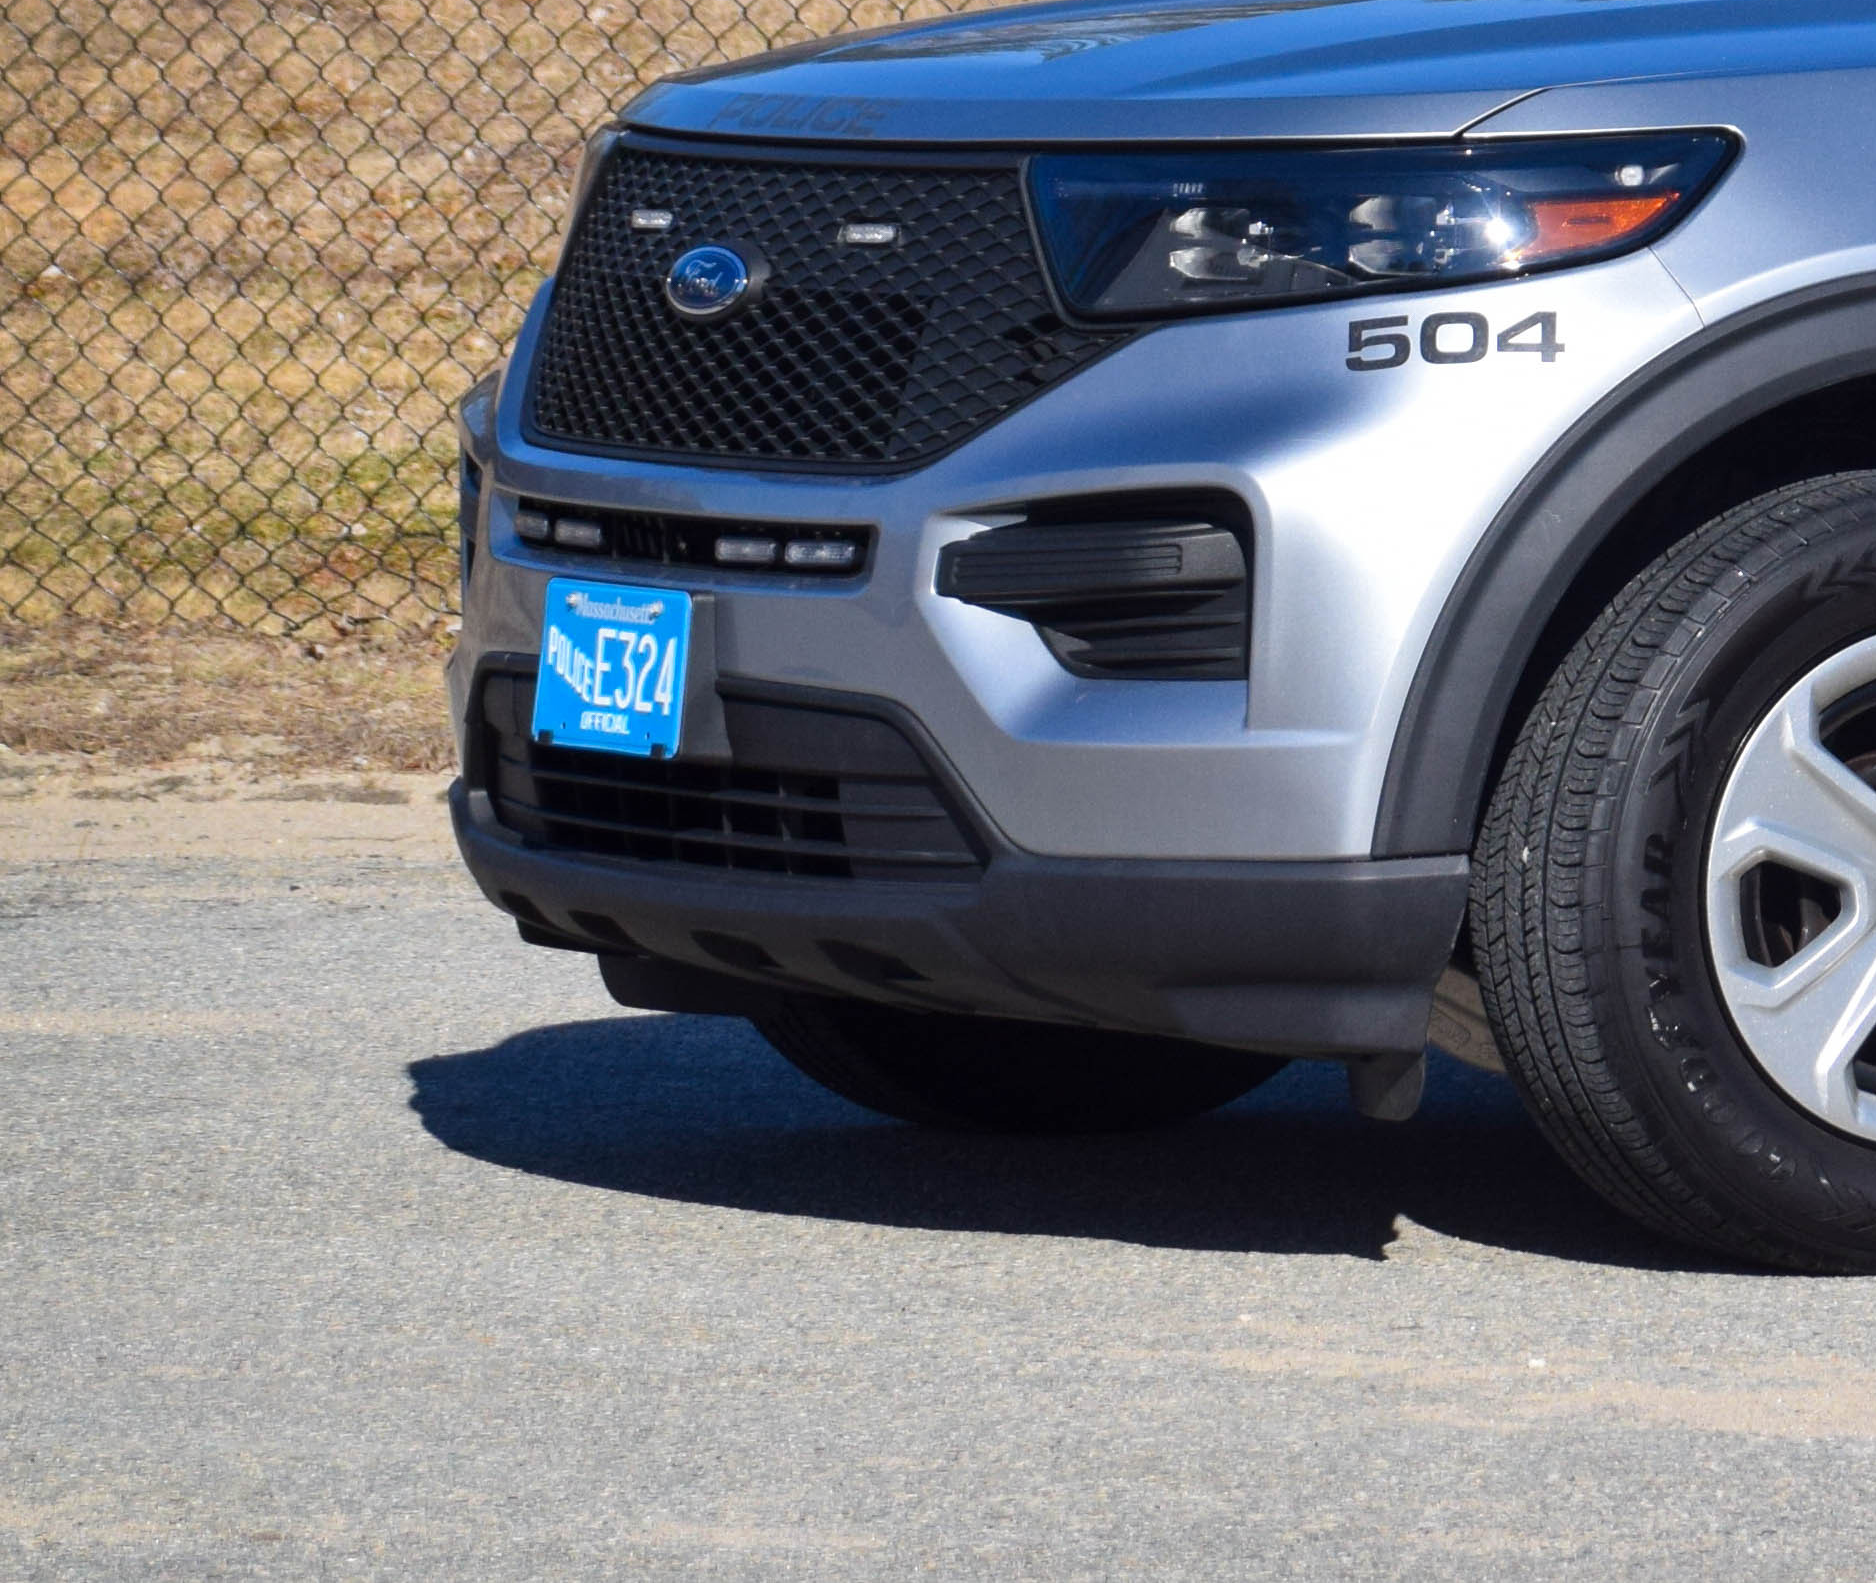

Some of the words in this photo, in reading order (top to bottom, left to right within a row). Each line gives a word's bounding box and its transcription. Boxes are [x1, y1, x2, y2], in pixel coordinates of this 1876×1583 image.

[684, 260, 723, 298] Ford
[1345, 311, 1565, 372] 504
[547, 625, 595, 703] POLICE
[592, 628, 678, 716] E324
[580, 711, 630, 735] OFFICIAL
